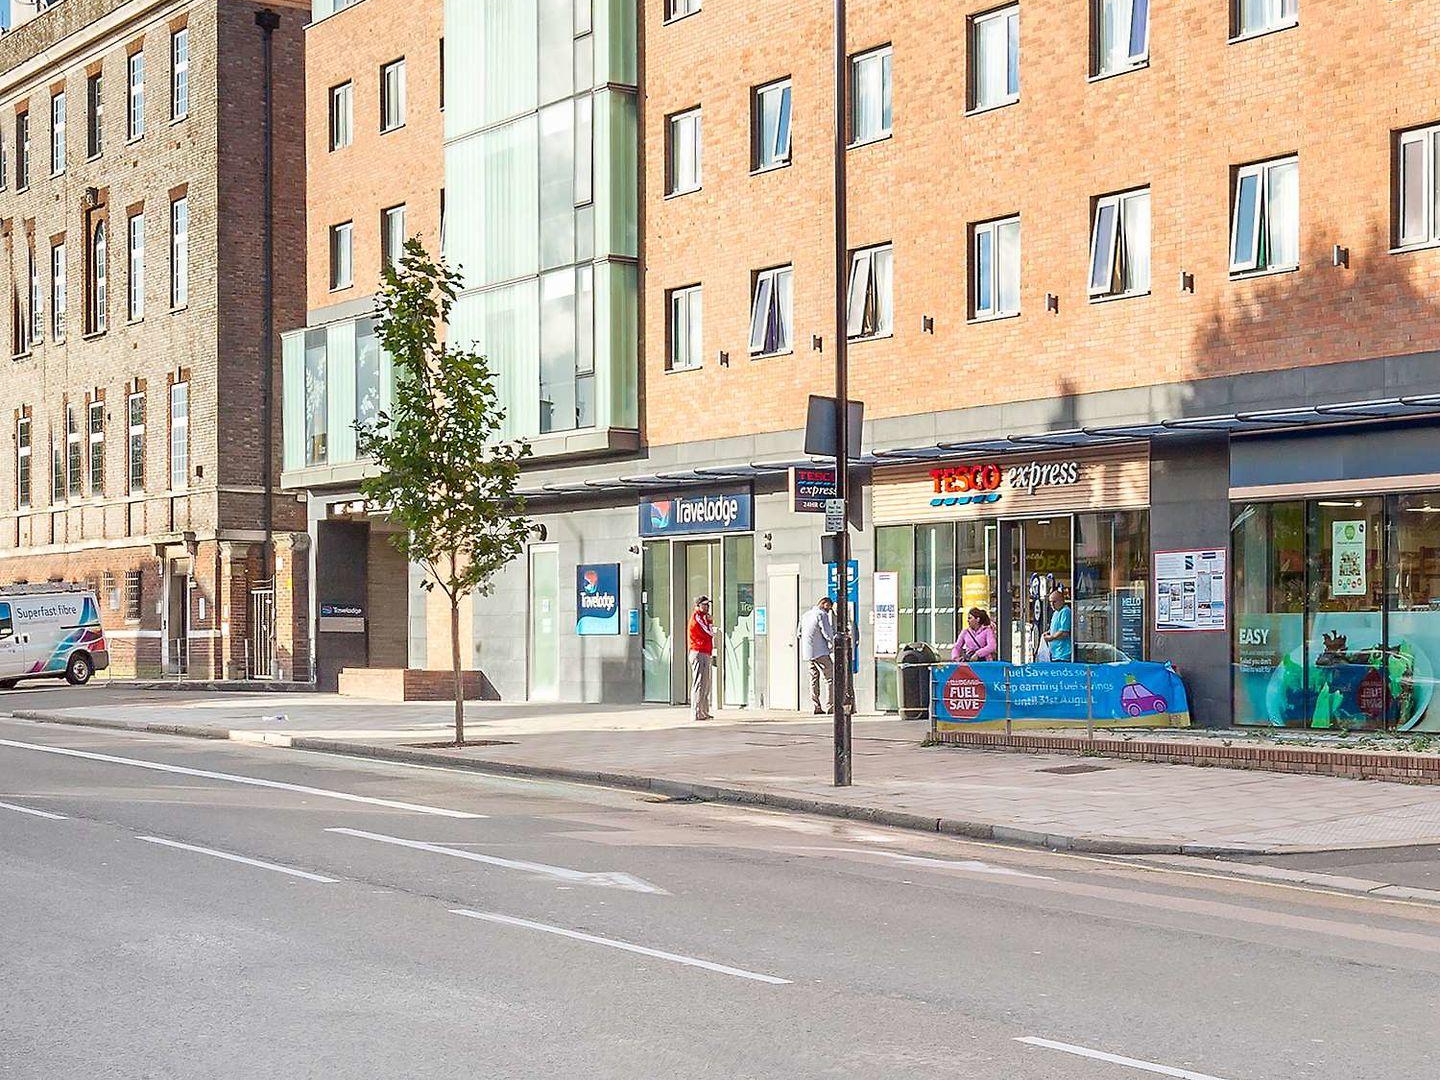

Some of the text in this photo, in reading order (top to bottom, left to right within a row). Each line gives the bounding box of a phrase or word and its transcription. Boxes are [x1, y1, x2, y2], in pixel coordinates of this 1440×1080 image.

[929, 461, 1079, 496] TESCO express
[675, 494, 738, 527] Travelodge
[579, 592, 616, 612] Travelodge
[16, 603, 77, 620] Superfast fibre
[1239, 628, 1269, 645] EASY
[1025, 665, 1049, 677] Save
[1050, 667, 1073, 677] ends
[950, 686, 979, 698] FUEL
[993, 681, 1018, 694] Kep
[1019, 681, 1059, 693] earning
[950, 699, 979, 710] SAVE
[1014, 695, 1038, 706] until
[1060, 696, 1098, 707] Augut.
